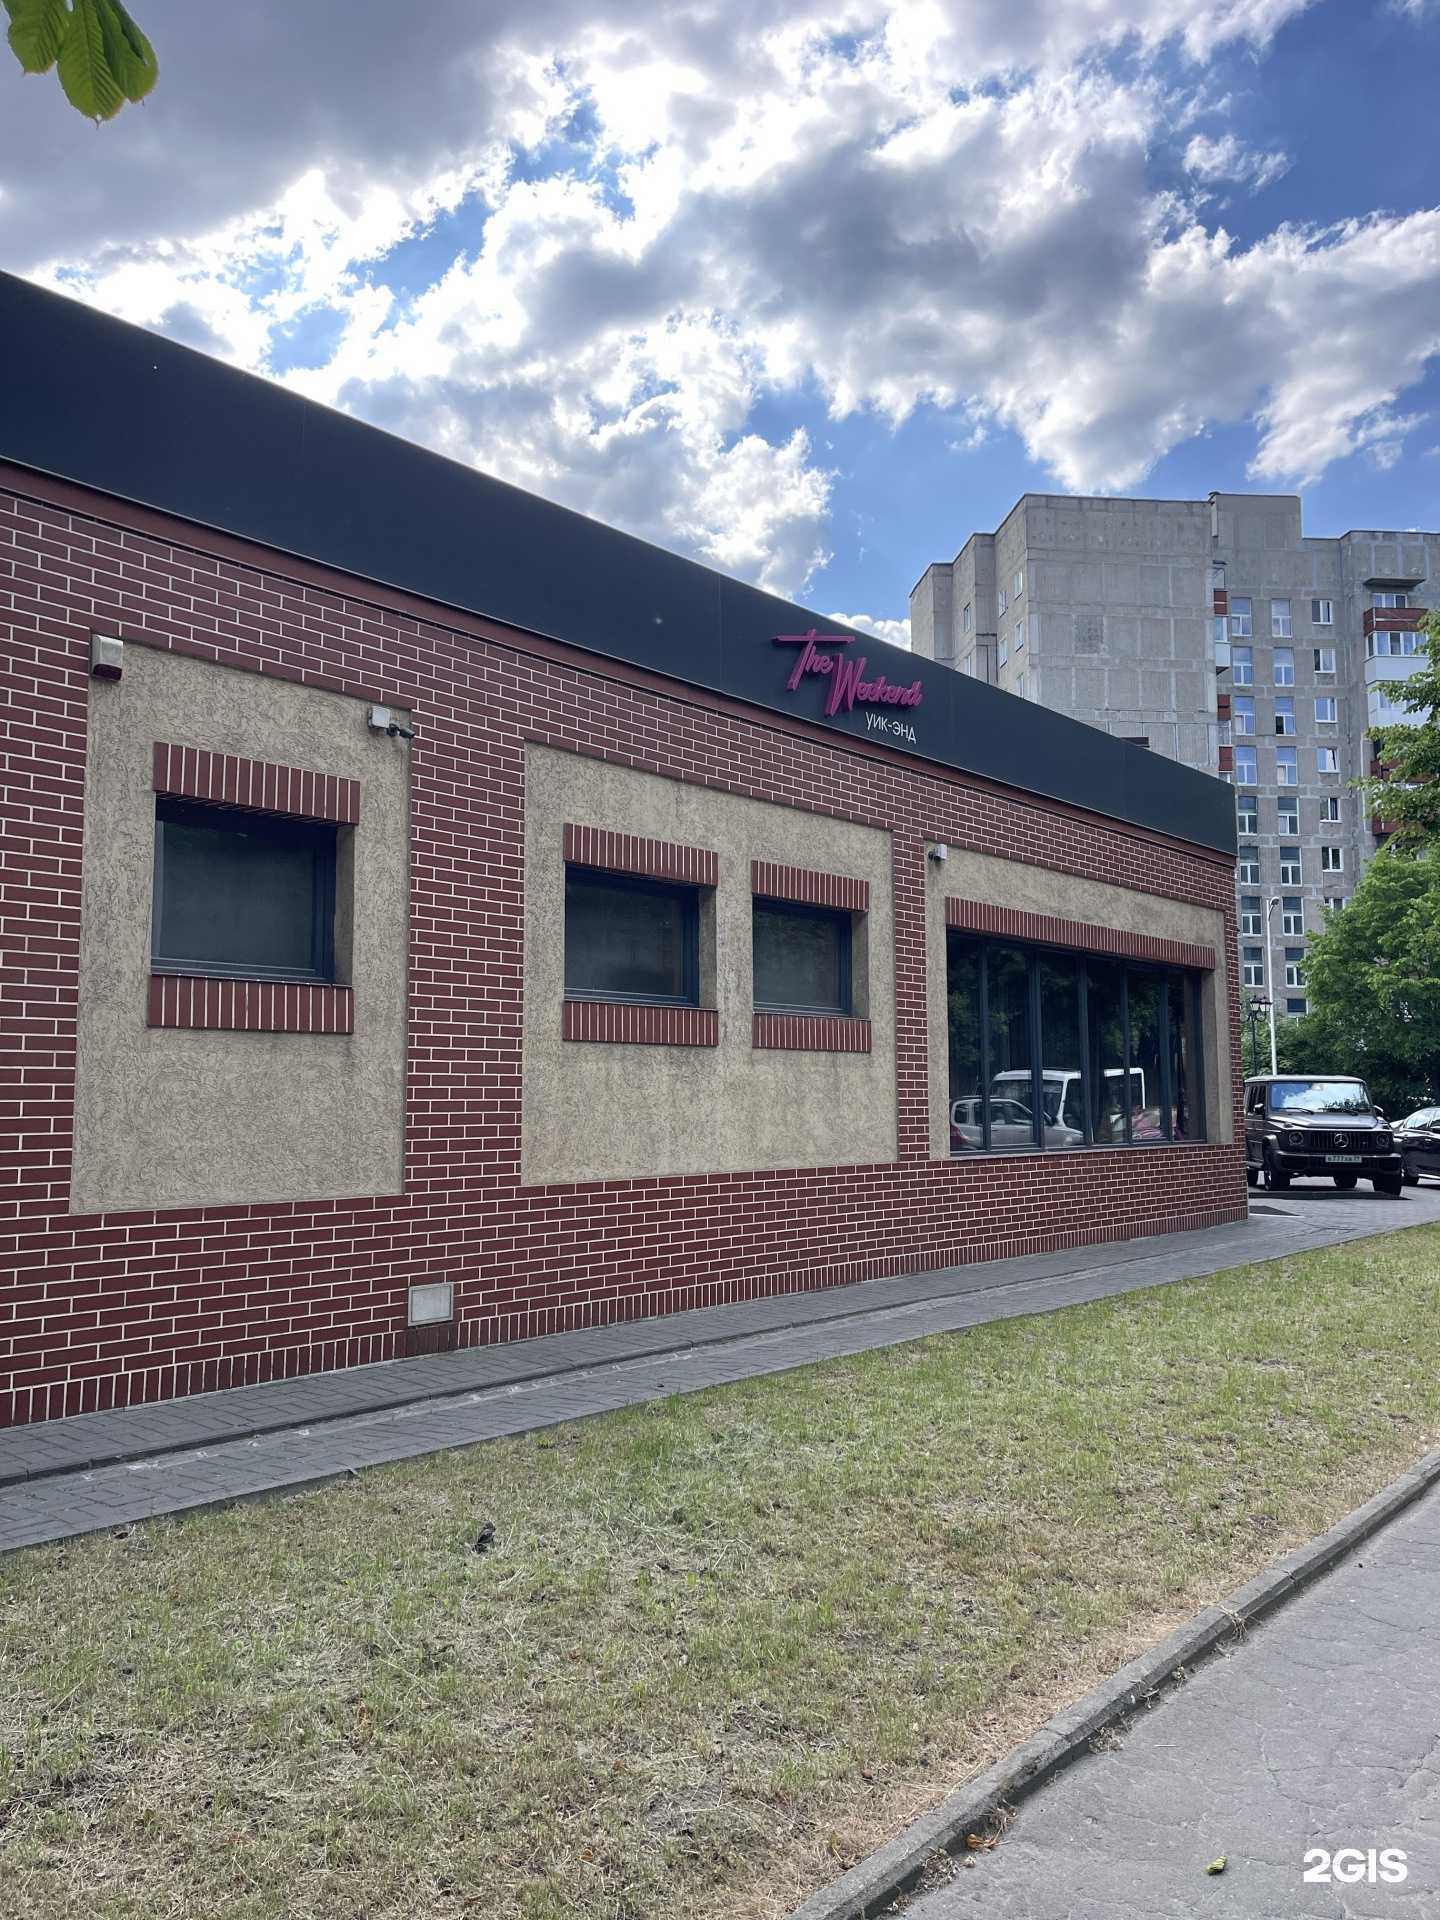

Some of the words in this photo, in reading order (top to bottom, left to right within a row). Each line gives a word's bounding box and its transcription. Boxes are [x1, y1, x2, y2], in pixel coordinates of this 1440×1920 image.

[770, 628, 856, 692] The
[825, 653, 923, 717] Weekend
[865, 711, 917, 745] УИК-ЭНД
